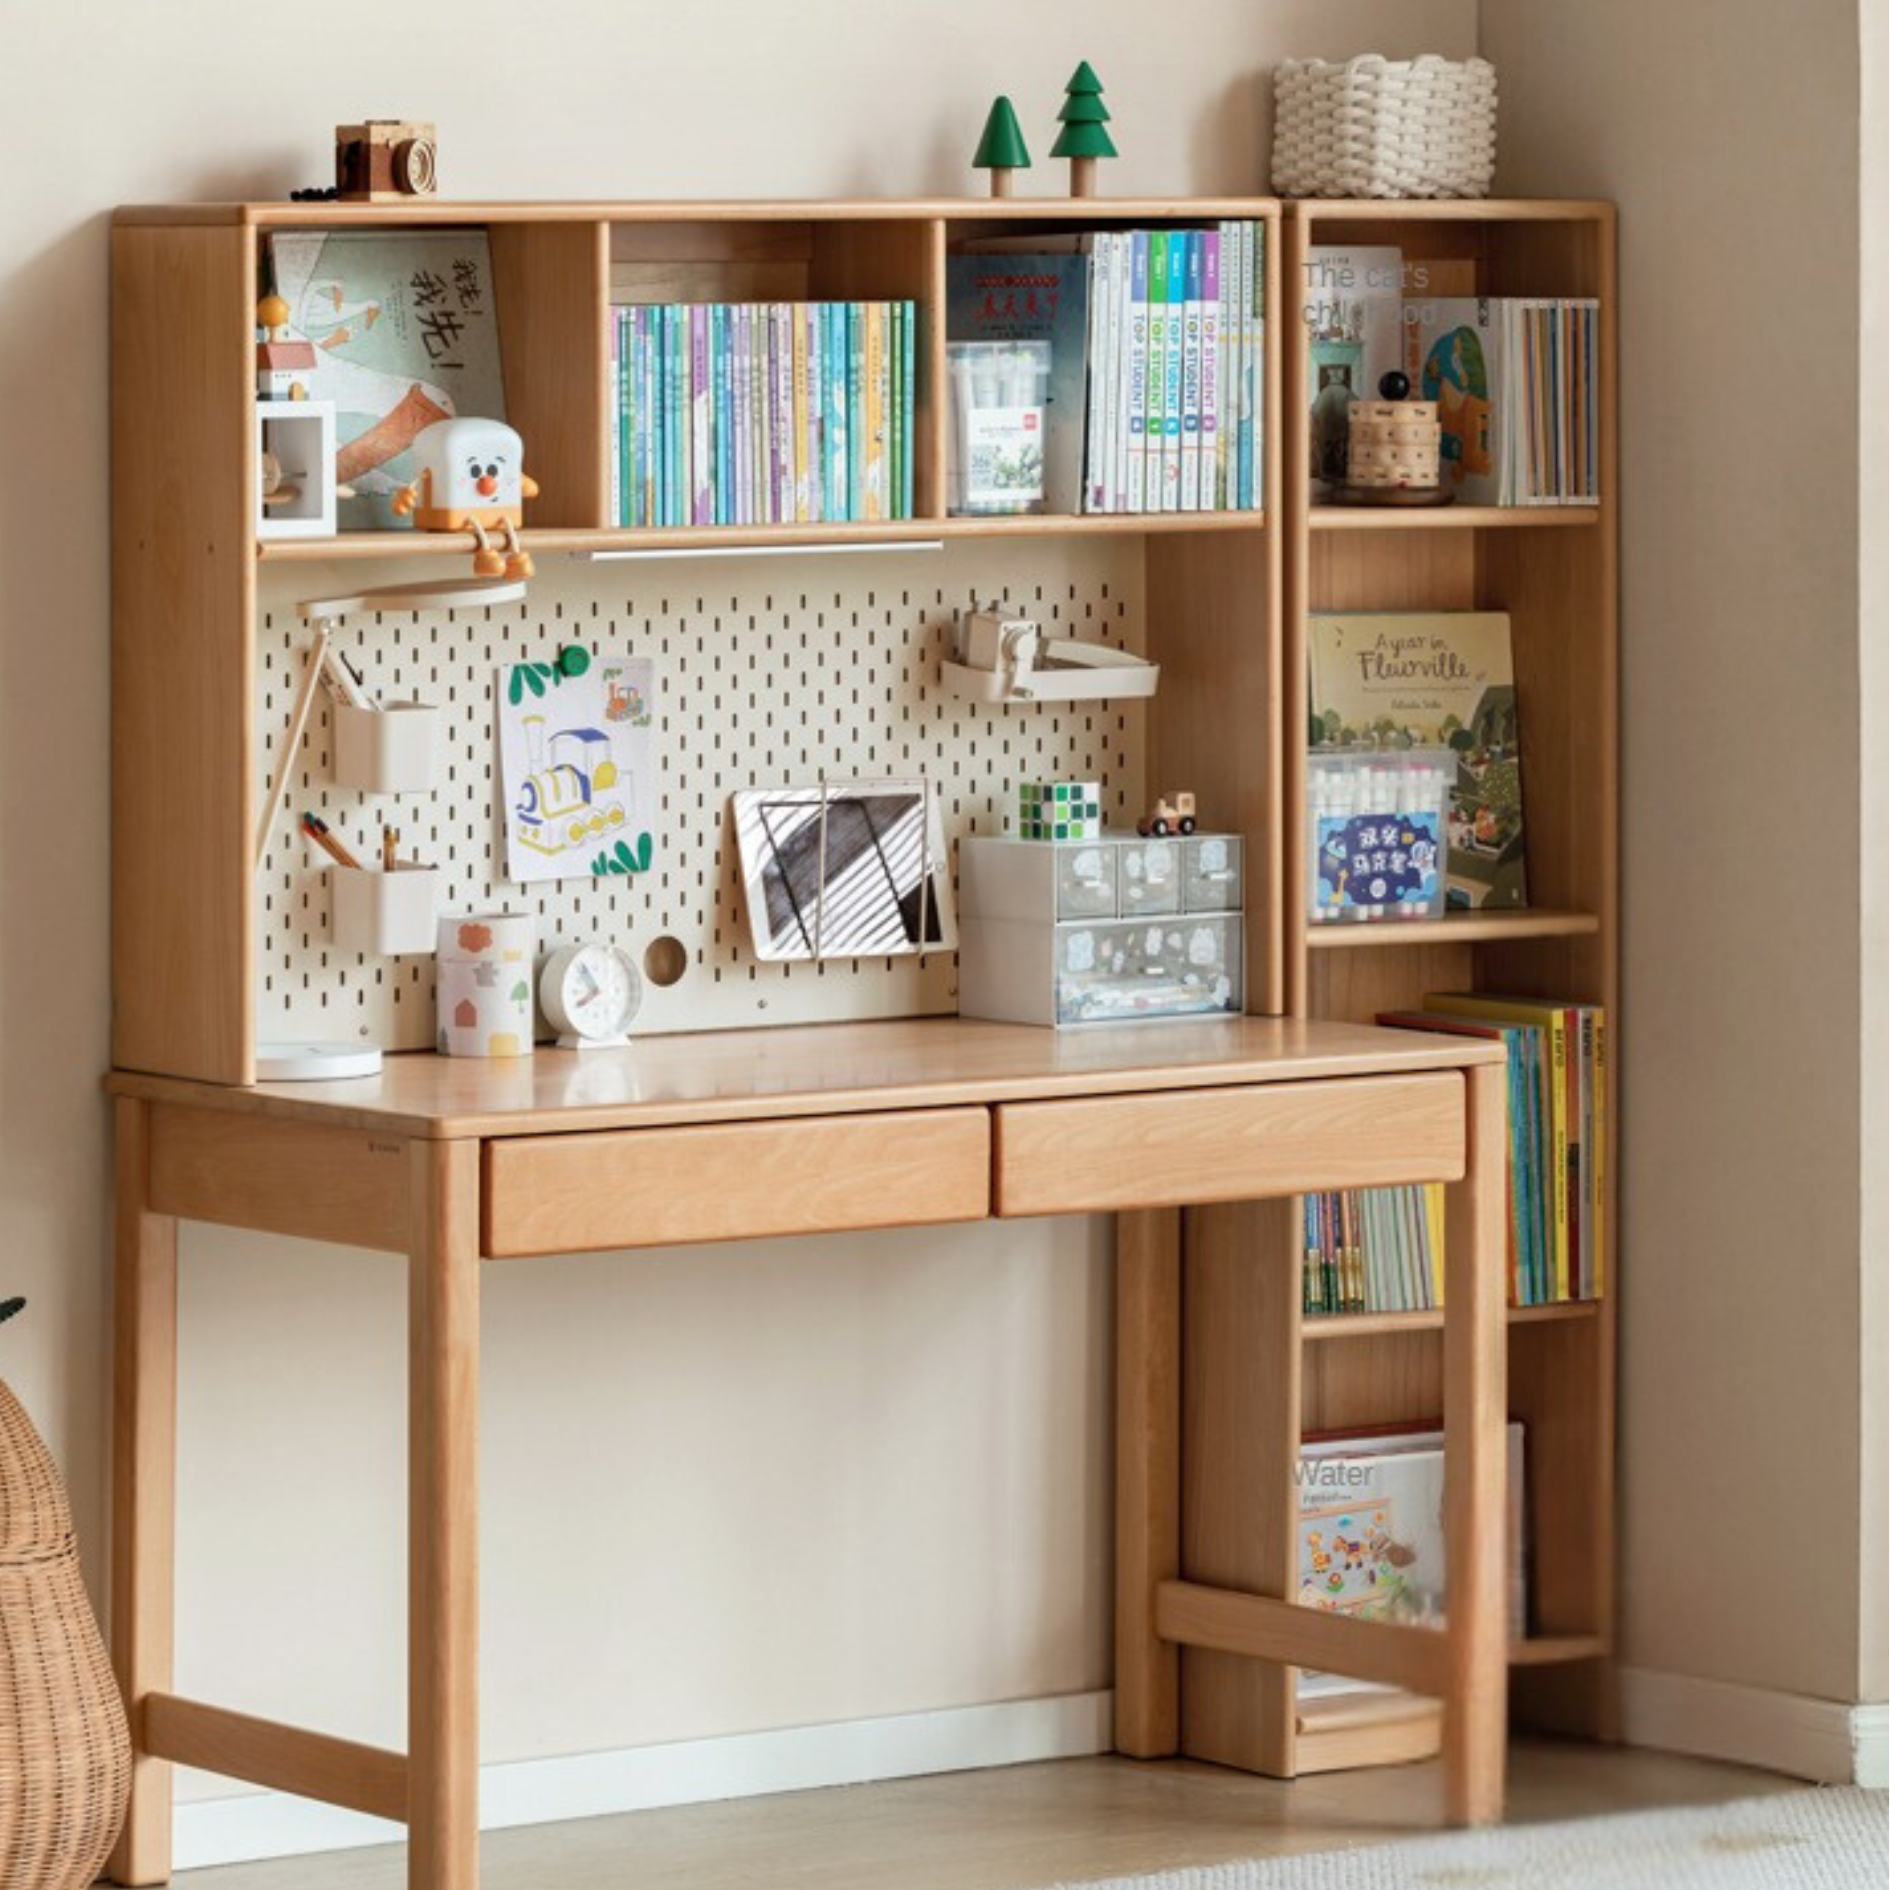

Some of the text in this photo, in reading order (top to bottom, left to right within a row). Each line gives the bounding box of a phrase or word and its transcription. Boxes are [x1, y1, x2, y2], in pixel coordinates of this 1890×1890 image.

[1133, 313, 1146, 343] TOP
[1151, 314, 1164, 345] TOP
[1168, 314, 1180, 345] TOP
[1186, 313, 1199, 342] TOP
[1203, 313, 1217, 342] TOP
[1185, 347, 1198, 408] STUDENT
[1203, 347, 1216, 409] STUDENT
[1375, 632, 1388, 650] A
[1389, 636, 1426, 659] year
[1356, 650, 1471, 681] Fleurville
